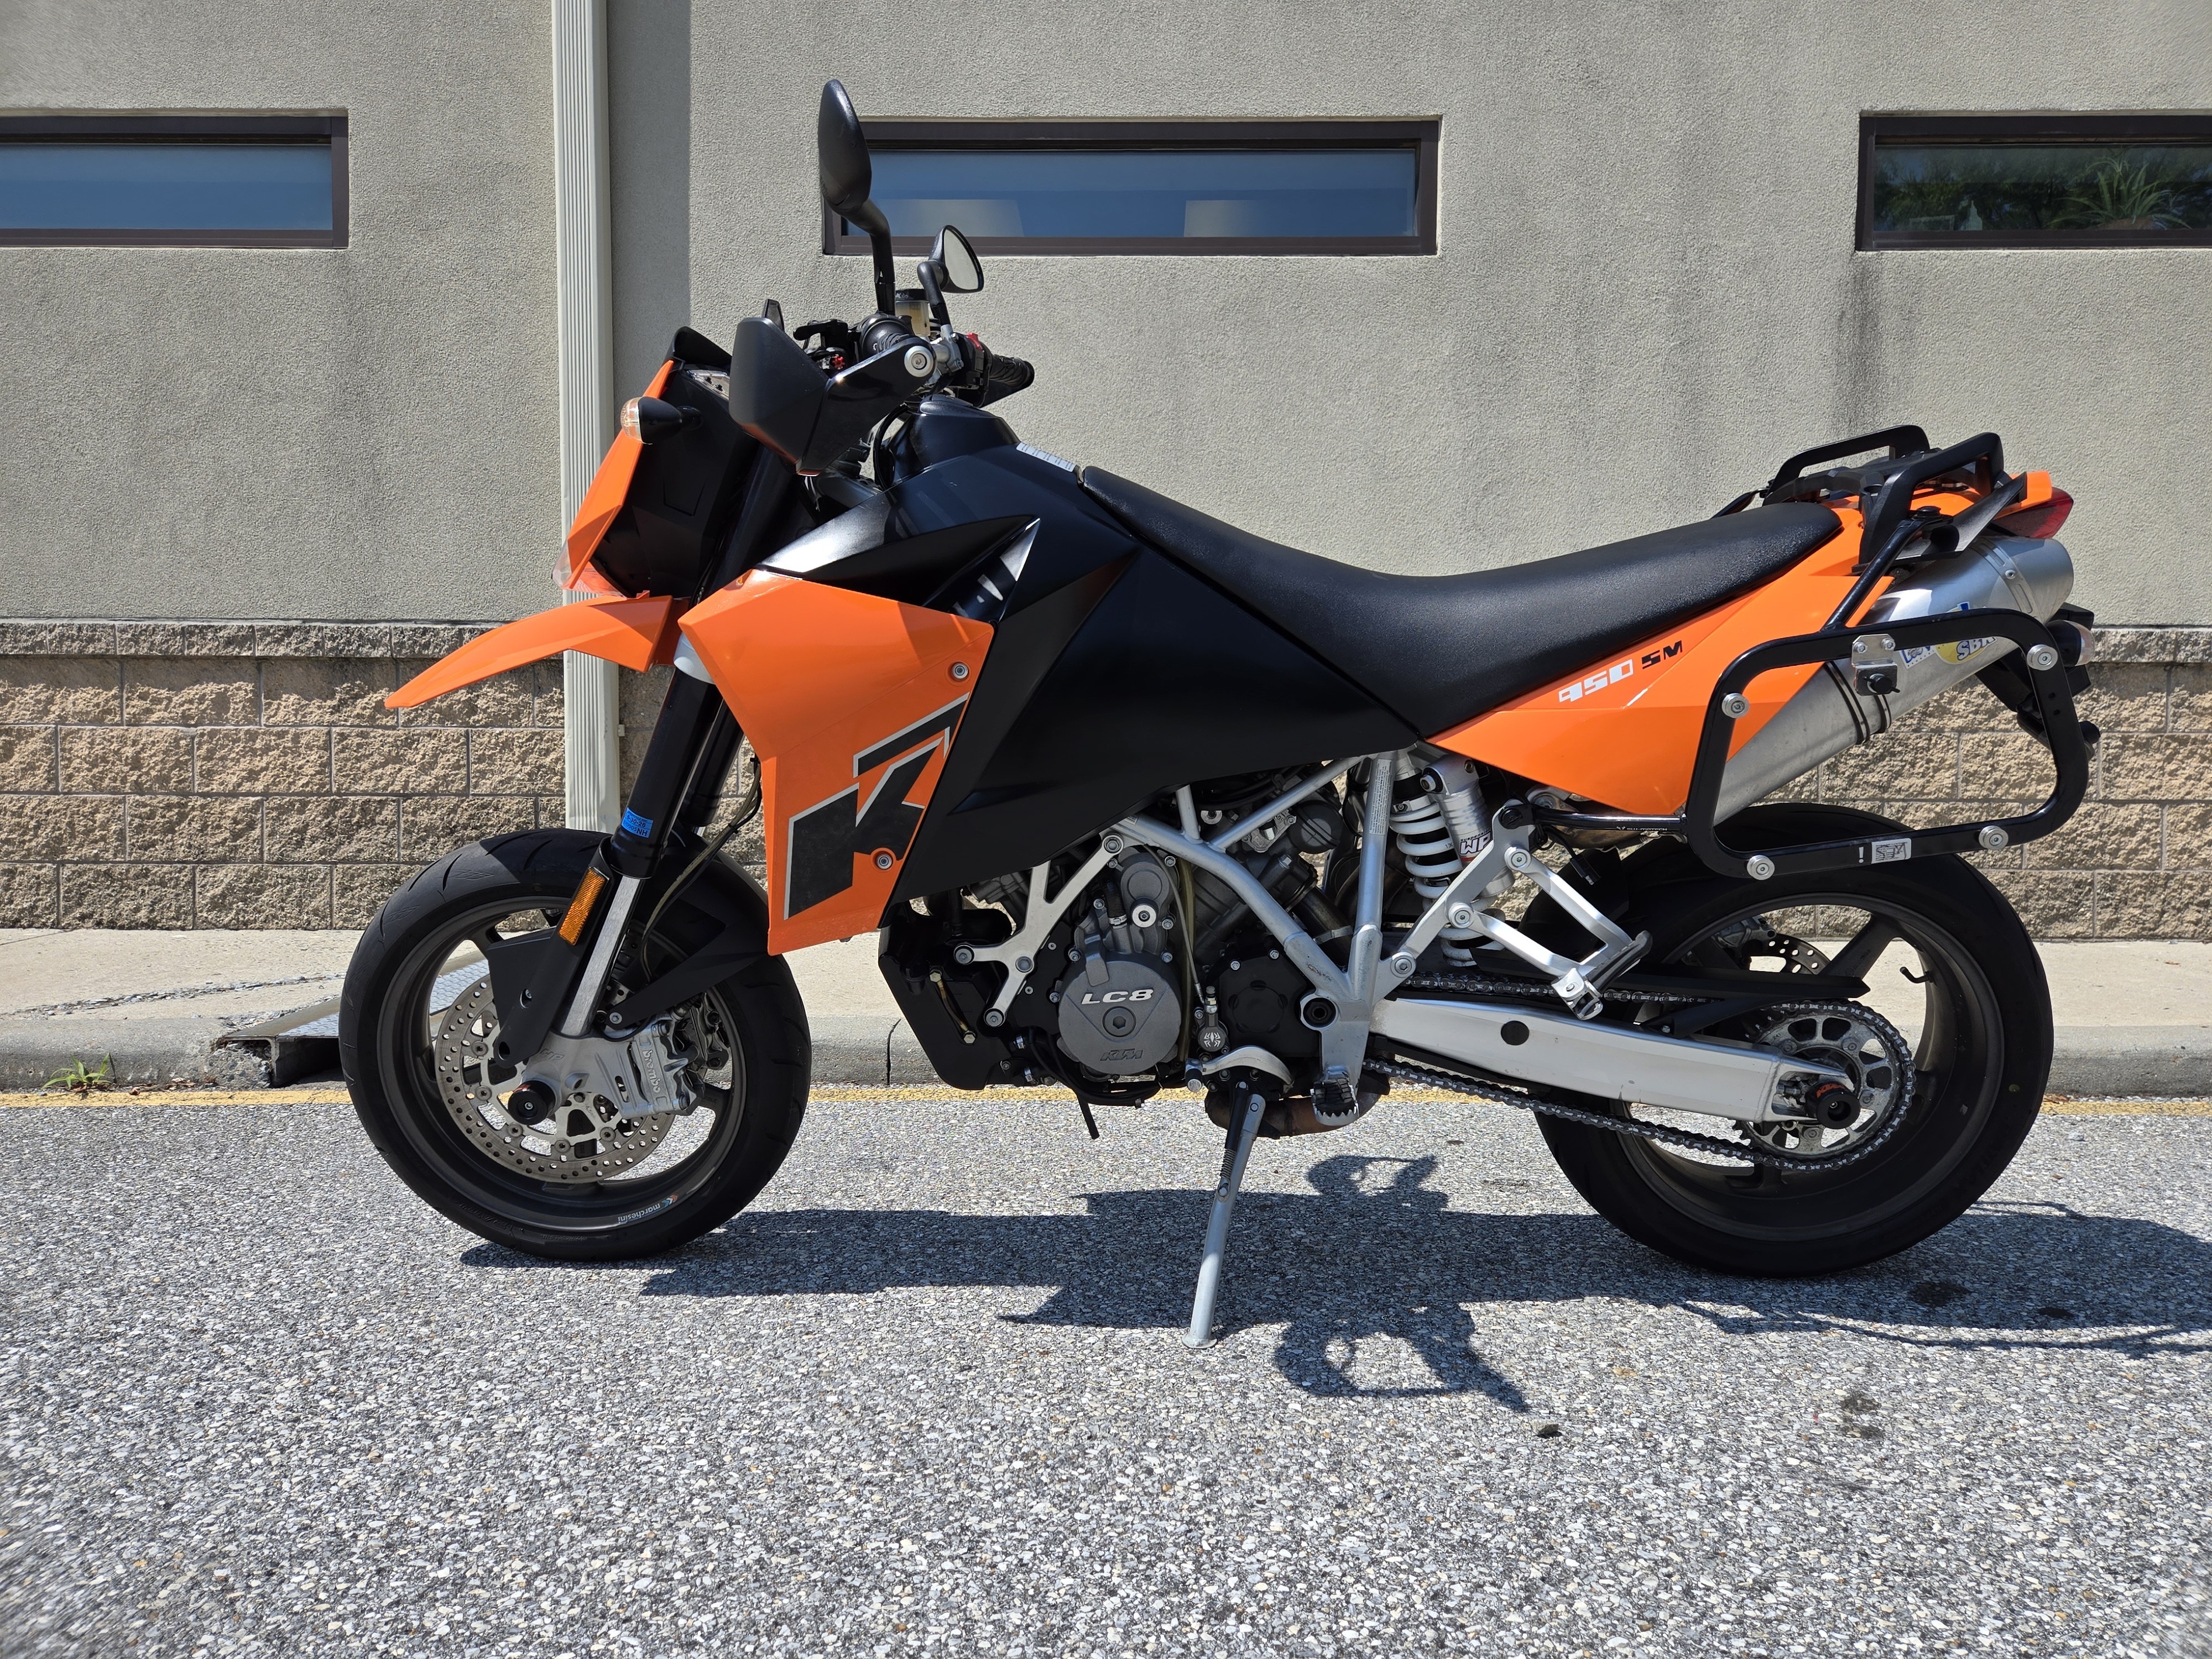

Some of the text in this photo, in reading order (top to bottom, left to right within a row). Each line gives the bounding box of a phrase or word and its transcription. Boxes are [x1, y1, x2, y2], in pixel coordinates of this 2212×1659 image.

[1558, 640, 1683, 702] 950 SM
[637, 828, 648, 837] NH
[1460, 830, 1491, 855] WP
[1081, 987, 1154, 1005] LC8
[1100, 1048, 1144, 1061] KTM
[642, 1049, 661, 1093] brembo
[617, 1203, 661, 1224] marchesini
